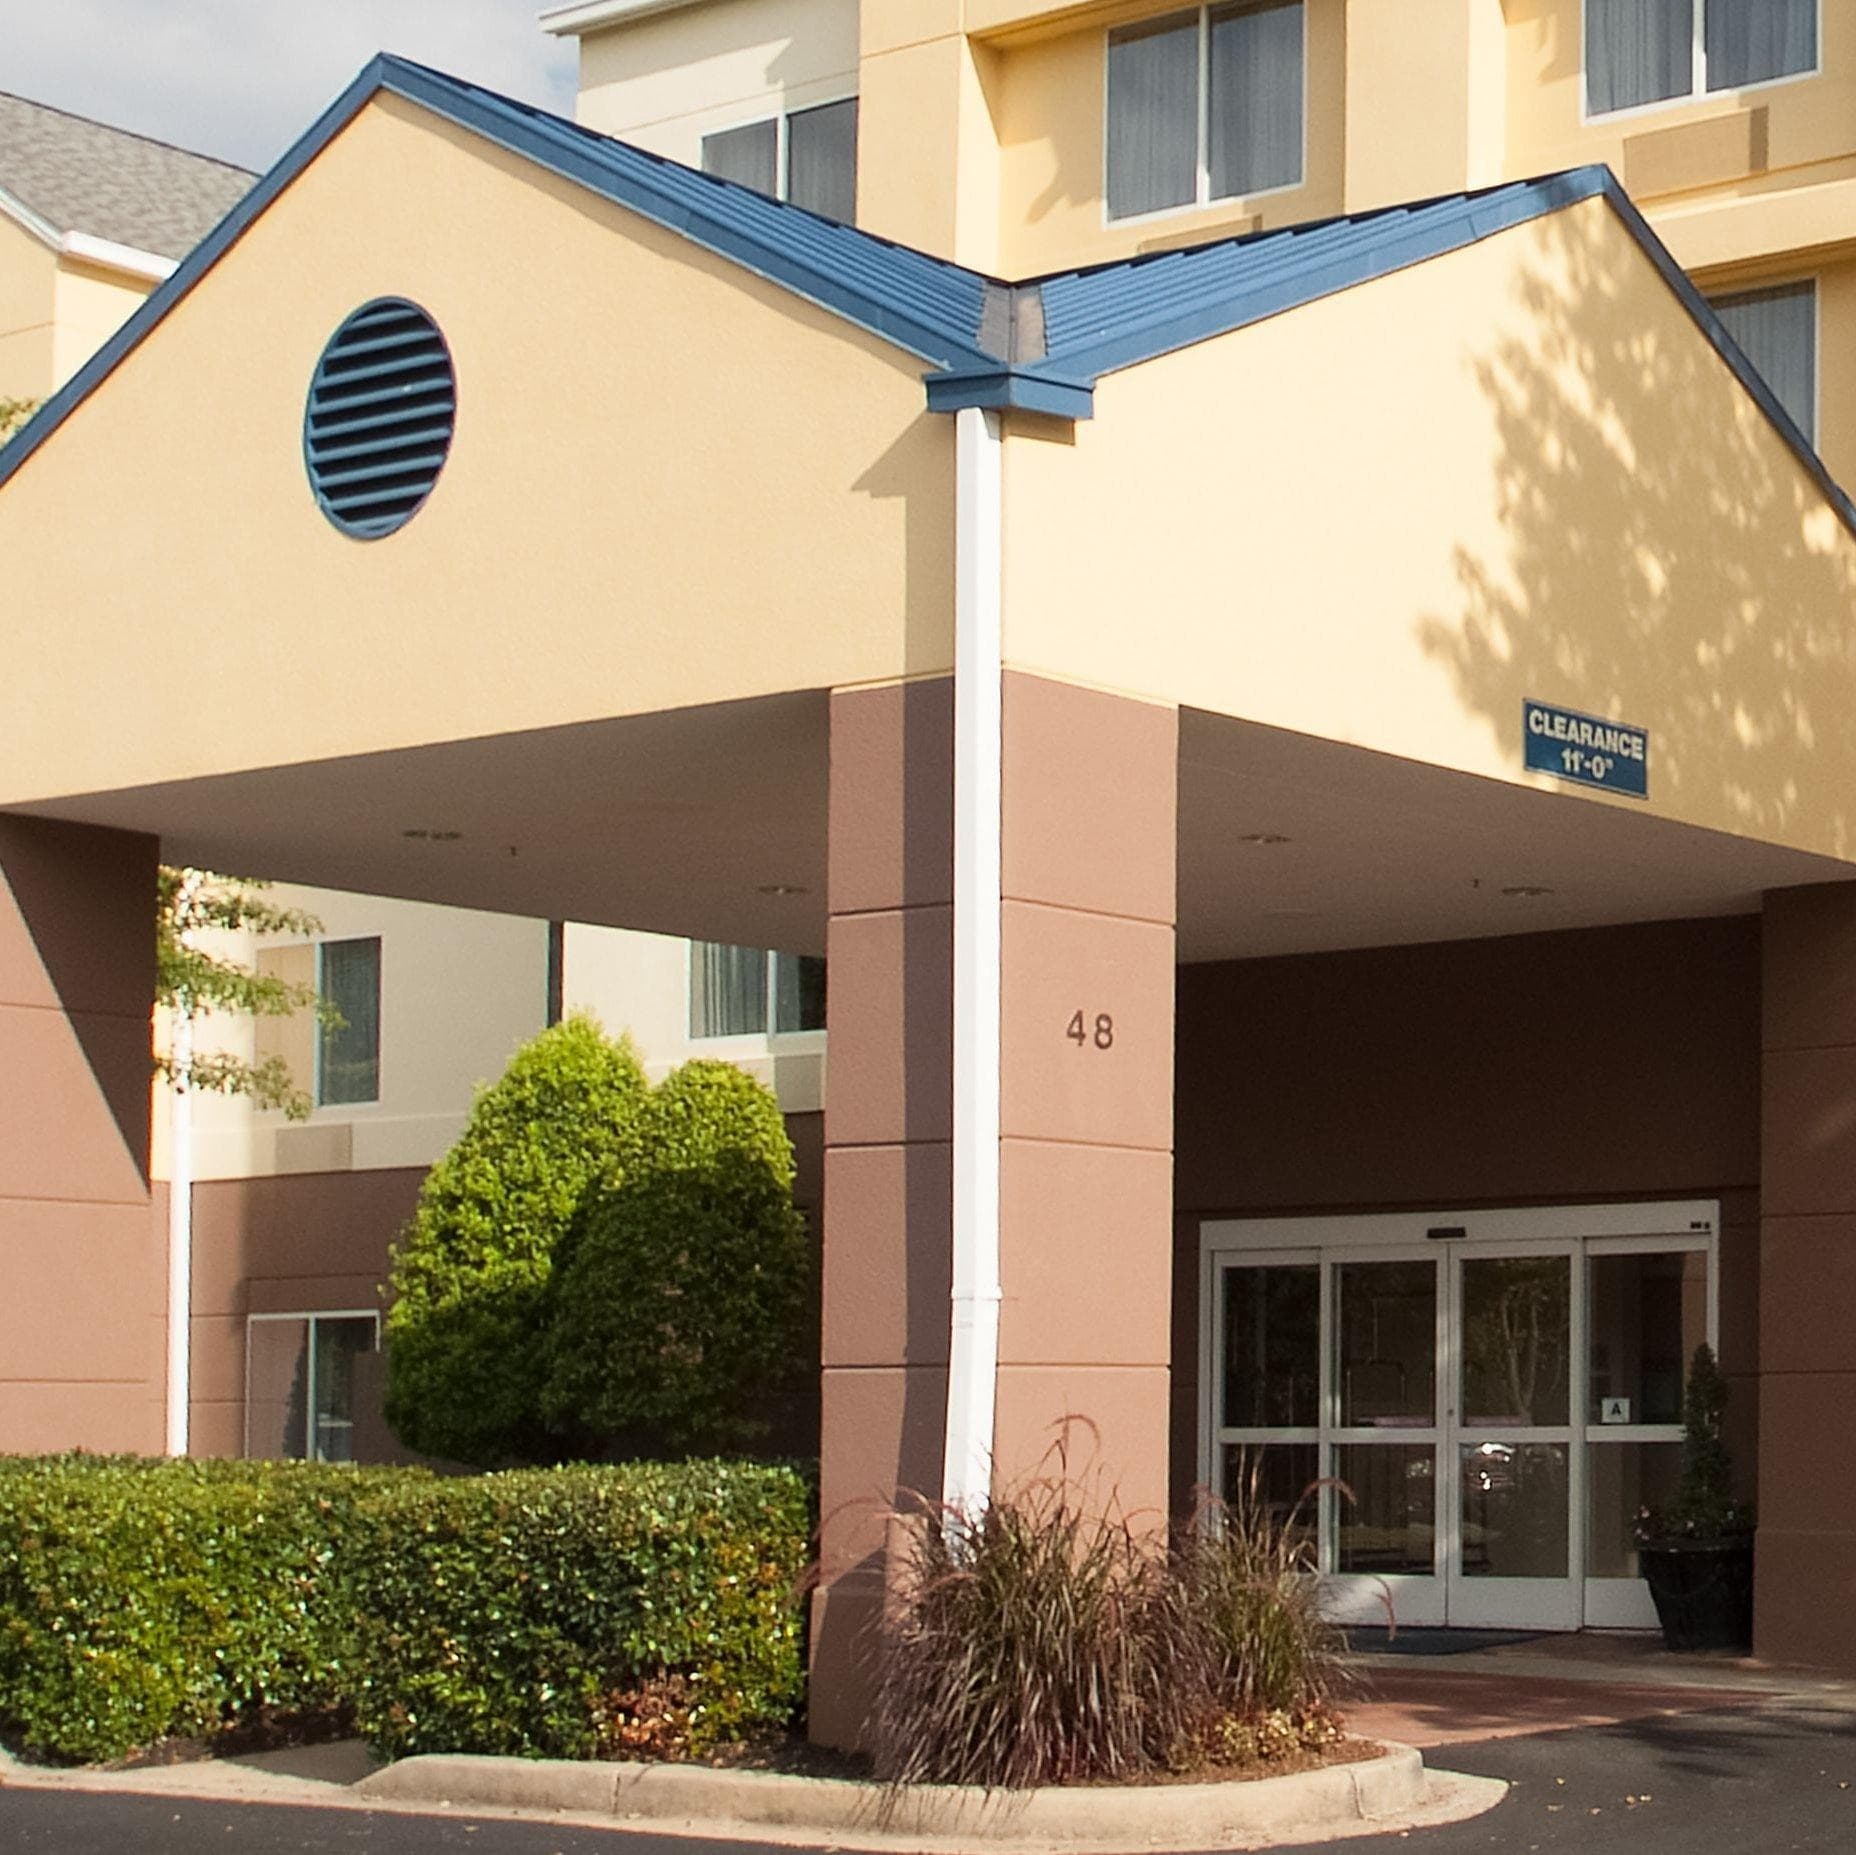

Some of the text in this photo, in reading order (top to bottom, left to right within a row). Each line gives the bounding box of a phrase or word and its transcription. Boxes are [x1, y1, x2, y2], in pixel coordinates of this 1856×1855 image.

[1529, 709, 1643, 760] CLEARANCE
[1066, 1010, 1113, 1049] 48
[1611, 1402, 1622, 1415] A
